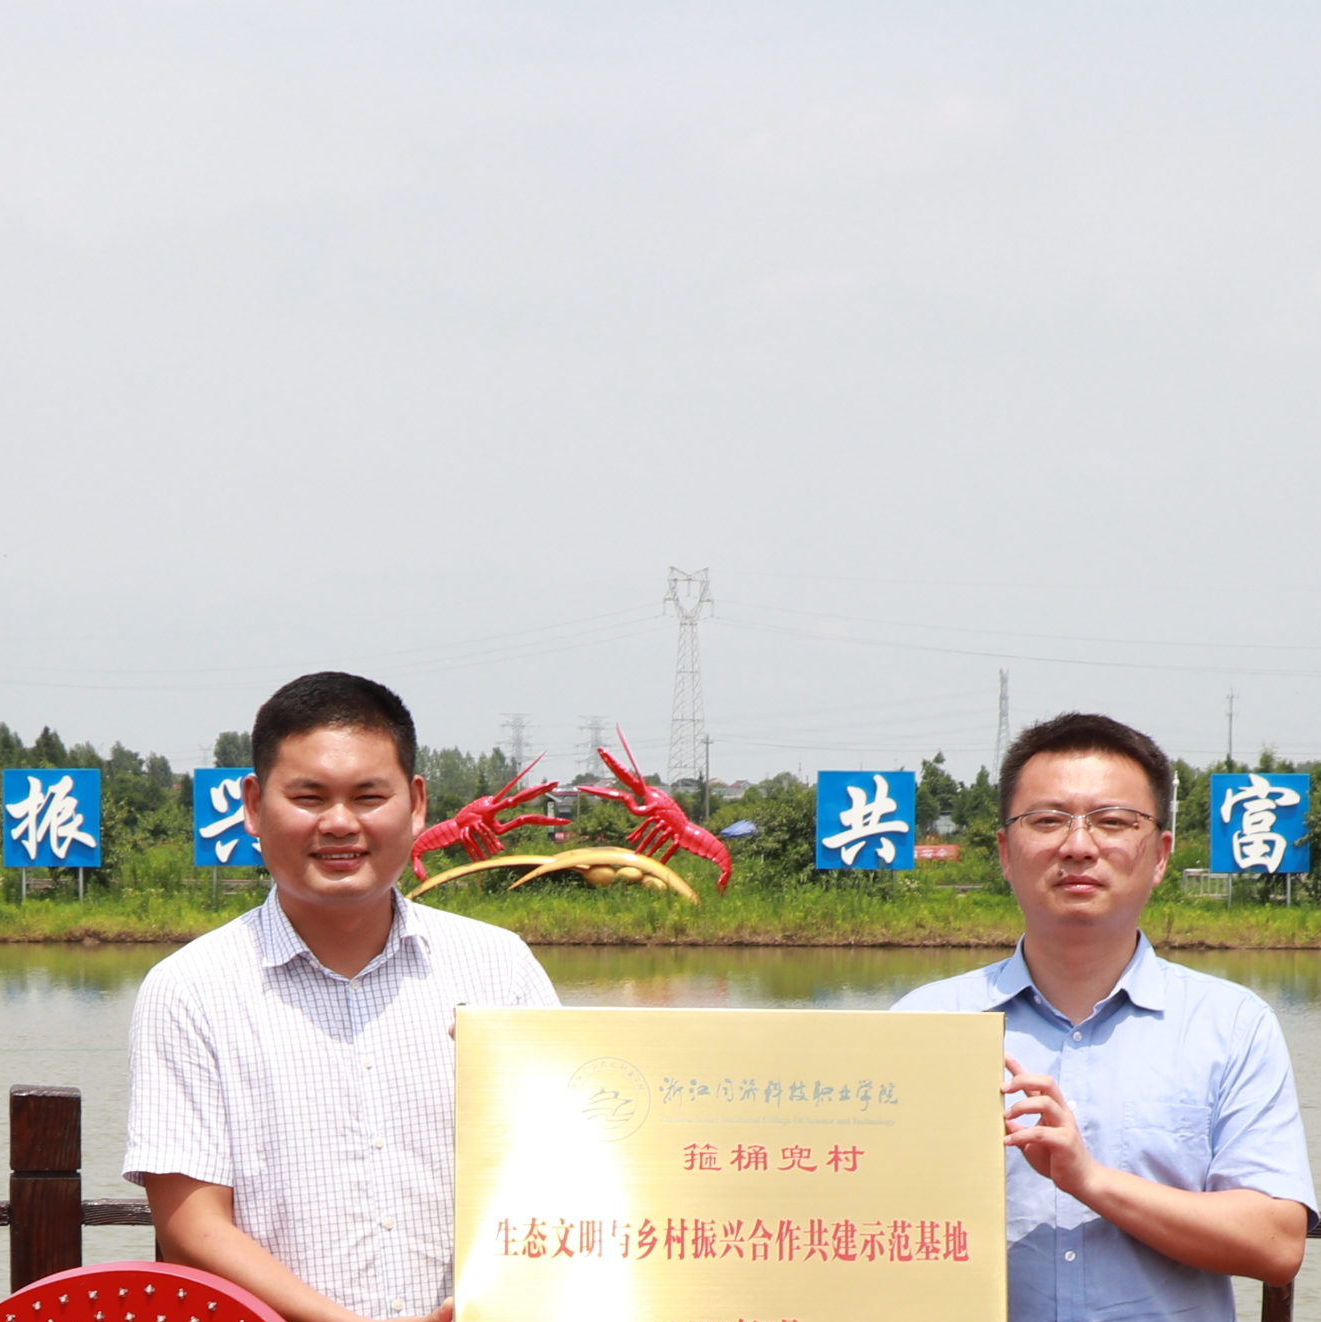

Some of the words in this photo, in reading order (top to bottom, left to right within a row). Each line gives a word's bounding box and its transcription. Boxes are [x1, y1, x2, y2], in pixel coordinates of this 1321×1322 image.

[5, 775, 97, 860] 振
[822, 774, 909, 866] 共
[1221, 774, 1300, 873] 富
[682, 1143, 865, 1173] 箍桶兜村
[495, 1217, 971, 1263] 生态文明与乡村振兴合作共建示范基地
